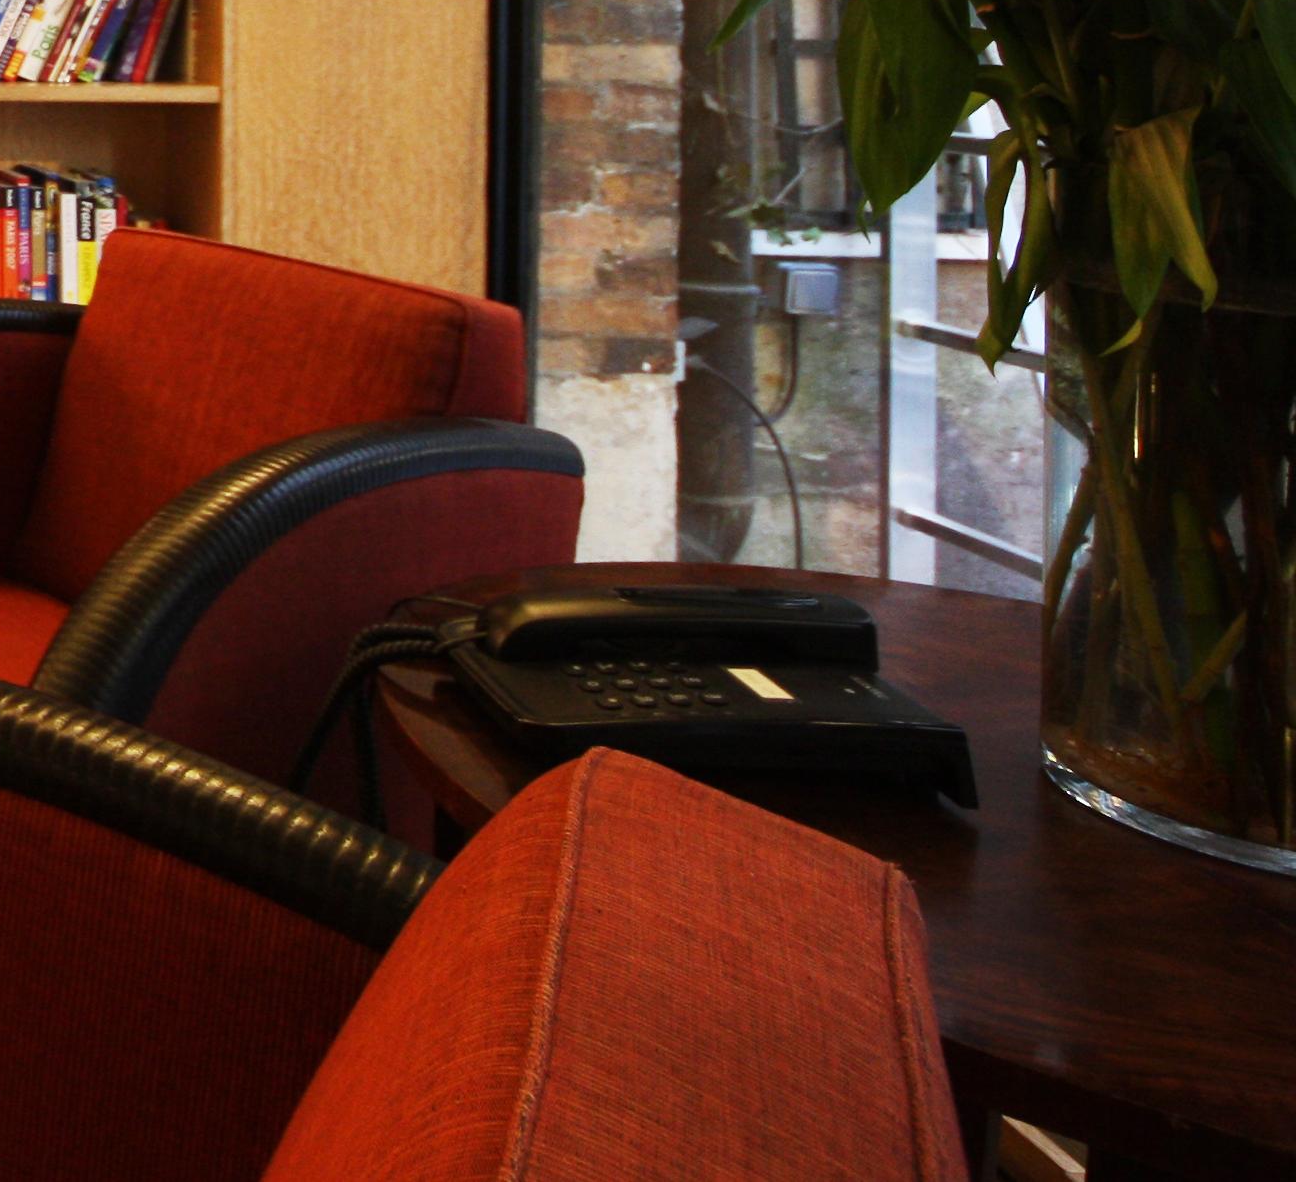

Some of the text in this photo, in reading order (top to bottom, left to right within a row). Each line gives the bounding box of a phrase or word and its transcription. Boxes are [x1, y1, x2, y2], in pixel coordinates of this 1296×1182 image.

[6, 220, 14, 244] PARIS
[81, 201, 91, 239] France
[19, 232, 28, 265] PARIS
